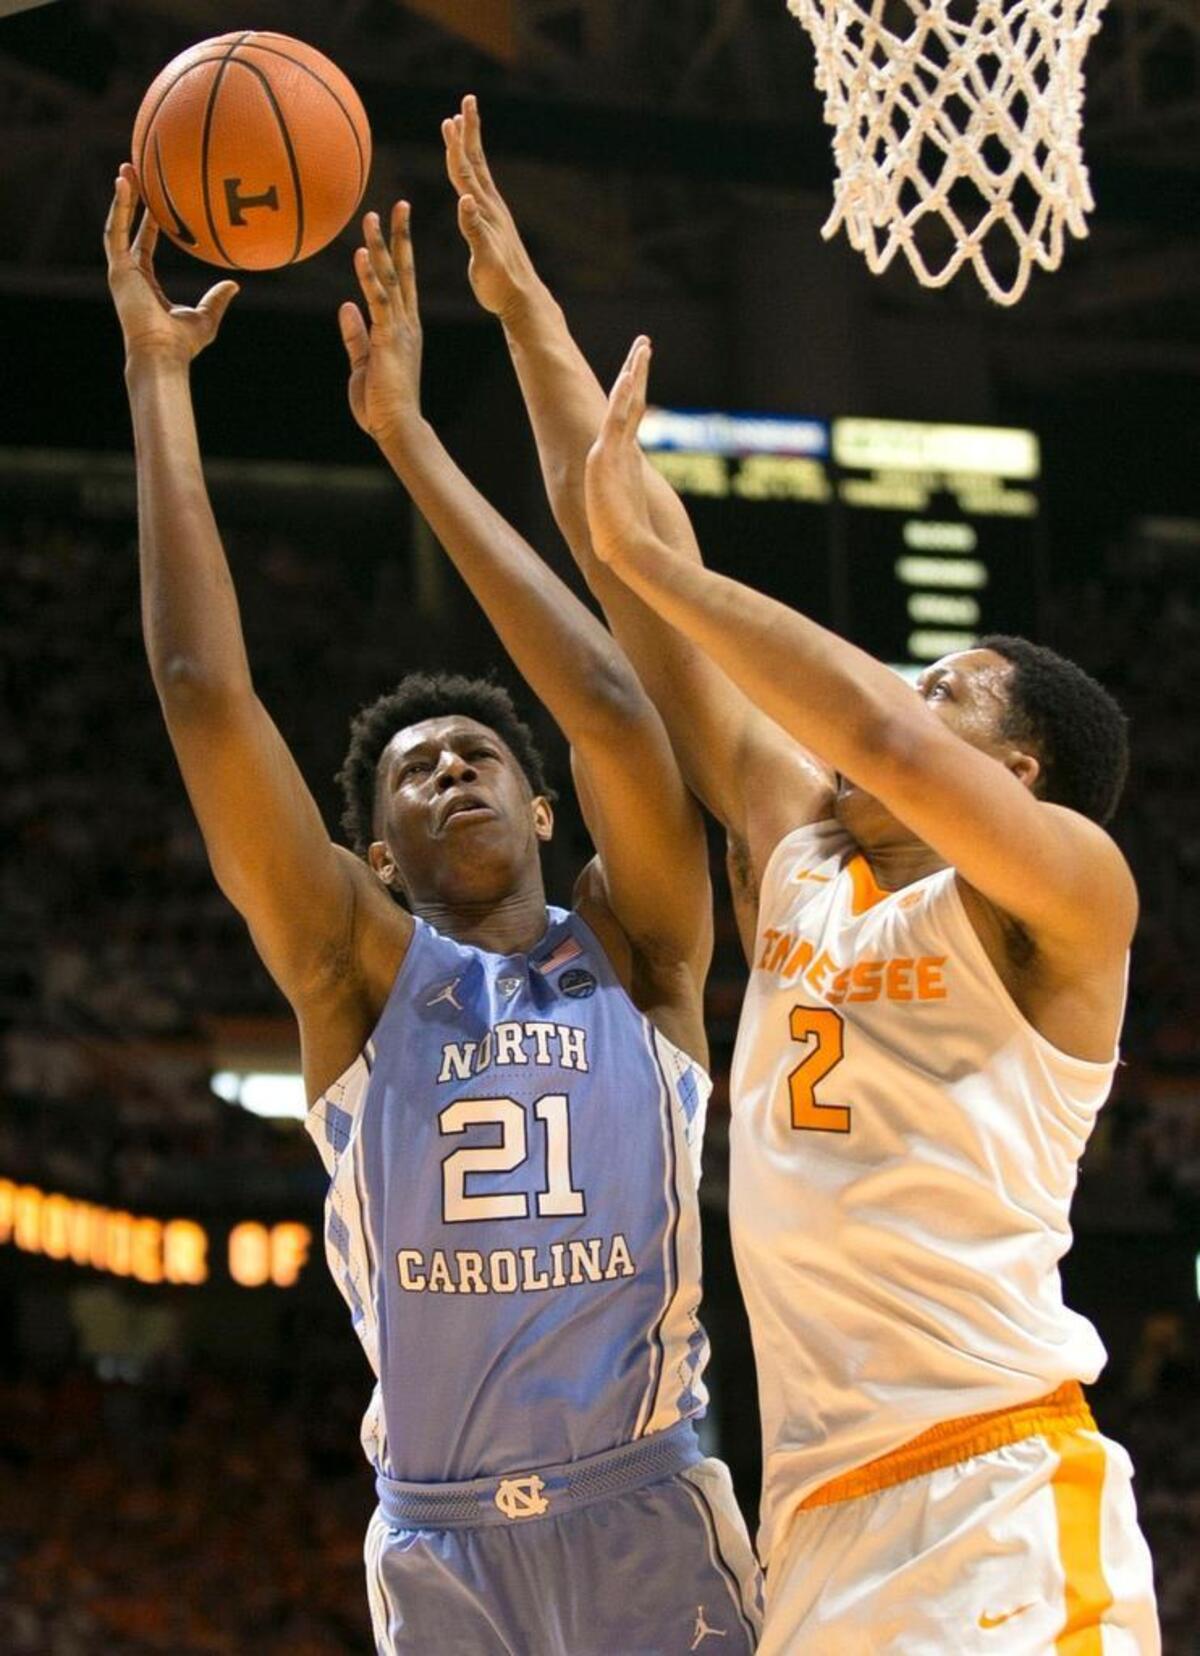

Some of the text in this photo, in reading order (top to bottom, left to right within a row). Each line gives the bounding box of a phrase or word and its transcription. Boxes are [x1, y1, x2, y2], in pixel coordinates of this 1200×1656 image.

[223, 178, 279, 227] T
[757, 929, 948, 1004] TNNESSEE
[436, 1020, 589, 1084] NORTH
[788, 1005, 851, 1134] 2
[438, 1093, 586, 1224] 21
[397, 1233, 636, 1294] CAROLINA
